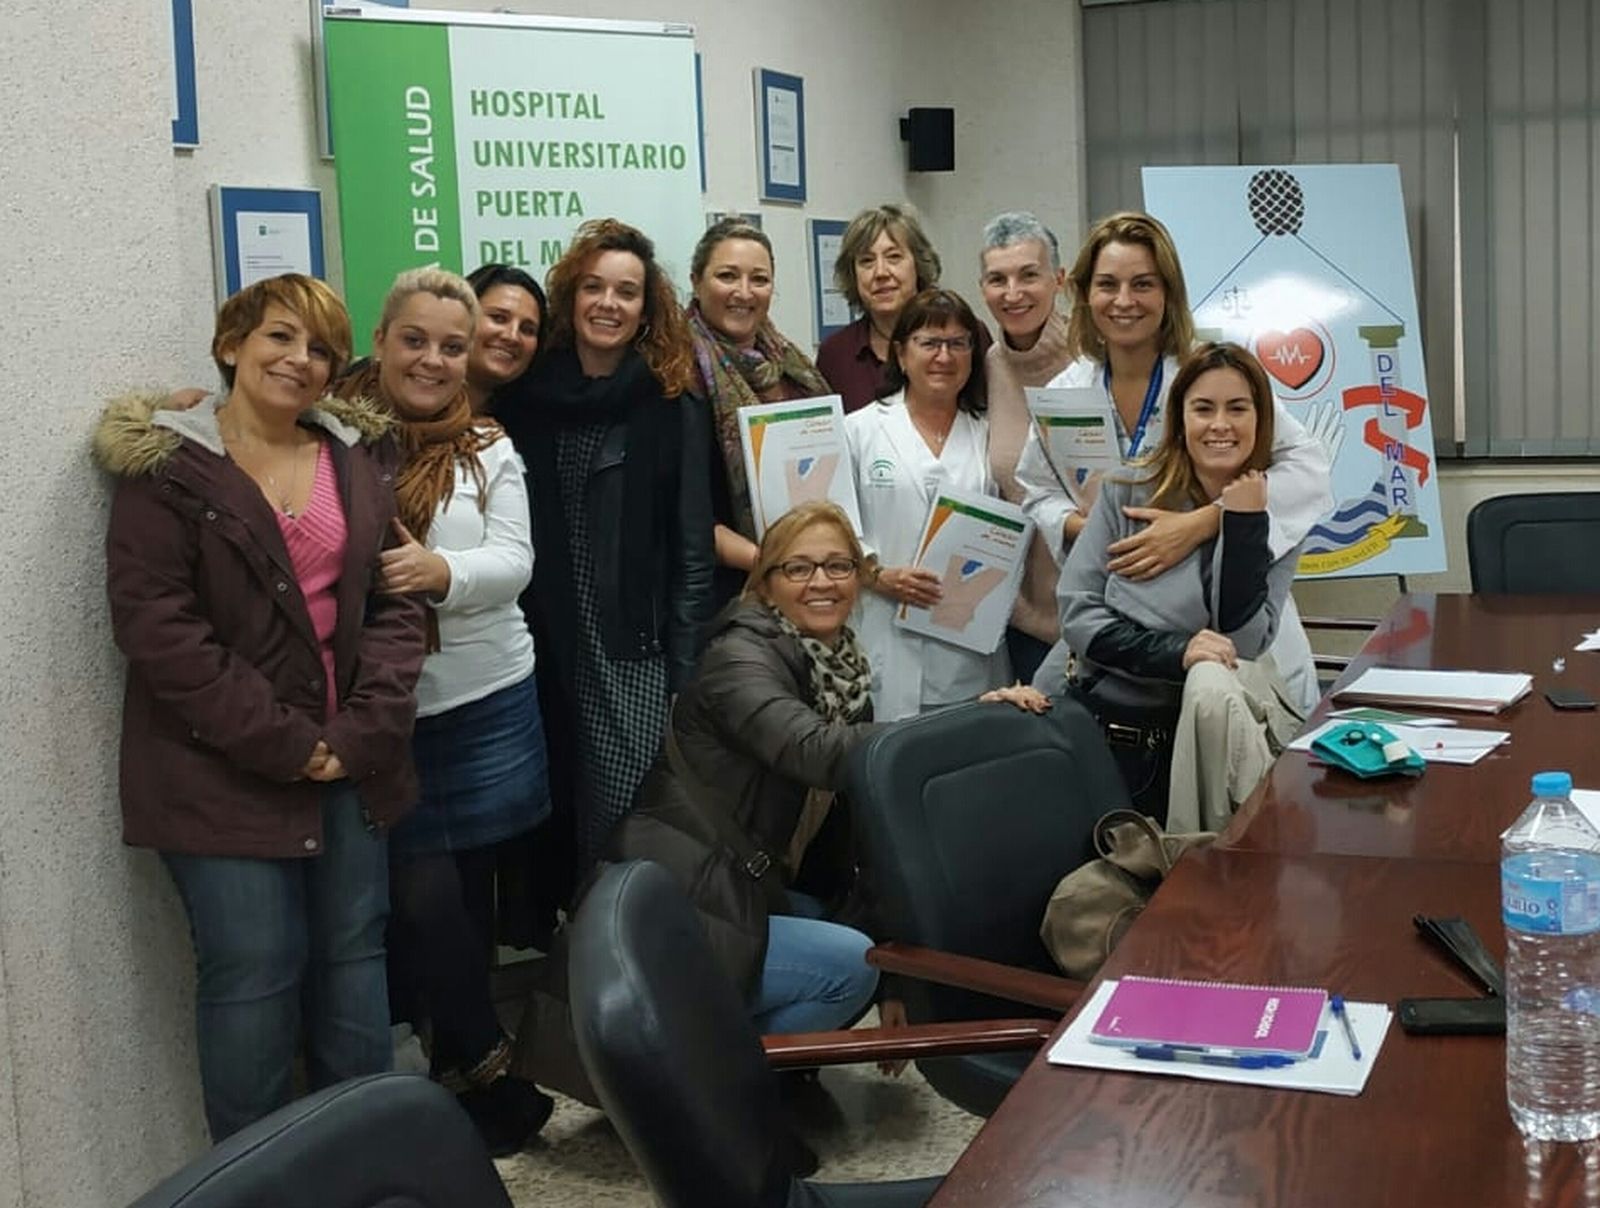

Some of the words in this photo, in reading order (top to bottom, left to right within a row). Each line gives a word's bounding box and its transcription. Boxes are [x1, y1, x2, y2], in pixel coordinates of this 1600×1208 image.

[470, 89, 606, 120] HOSPITAL
[405, 85, 437, 198] SALUD
[473, 140, 686, 170] UNIVERSITARIO
[476, 190, 584, 217] PUERTA
[412, 207, 440, 252] DE
[480, 240, 530, 266] DEL
[1377, 354, 1398, 417] DEL
[1386, 442, 1409, 506] MAR
